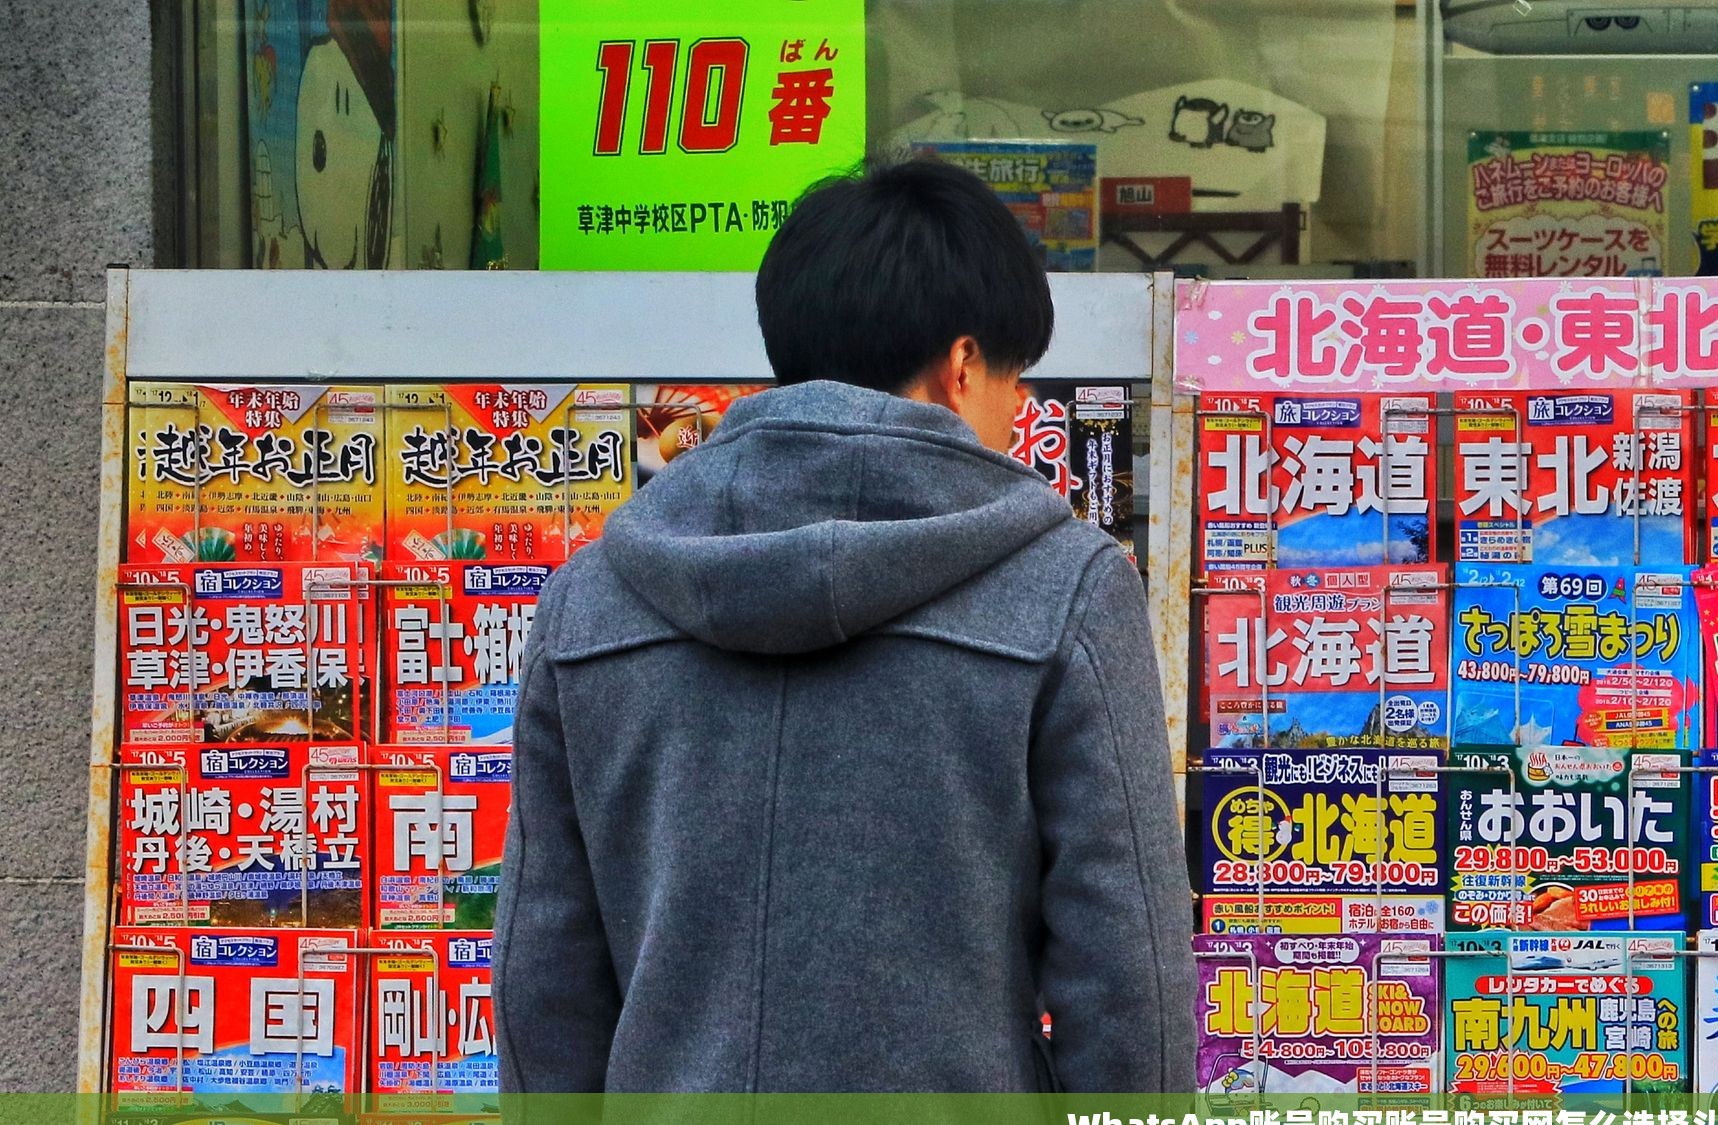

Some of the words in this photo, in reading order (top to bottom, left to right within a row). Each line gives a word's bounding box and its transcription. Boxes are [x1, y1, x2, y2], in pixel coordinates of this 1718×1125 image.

[779, 39, 839, 61] ばん
[578, 203, 792, 236] 草津中学校区PTA・防犯
[1488, 228, 1650, 250] スーツケースを
[1484, 254, 1628, 277] 無料レンタル
[229, 391, 300, 409] 年末年始
[246, 410, 280, 428] 特集
[153, 426, 376, 487] 越年お正月
[401, 426, 623, 487] 越年お正月
[1613, 432, 1681, 472] 新潟
[1102, 433, 1113, 525] お正月におすすめの
[1207, 434, 1429, 516] 北海道
[1458, 436, 1610, 517] 東北
[1613, 477, 1682, 517] 佐渡
[1275, 595, 1383, 613] 観光周遊プラン
[1542, 576, 1603, 596] 第69回
[126, 605, 347, 646] 日光・鬼怒川
[1458, 605, 1682, 664] さっぽろ雪まつり
[127, 650, 348, 690] 草津・伊香保
[1217, 616, 1435, 687] 北海道
[132, 787, 359, 834] 城崎・湯村
[1292, 794, 1437, 864] 北海道
[1460, 790, 1473, 841] おんせん県
[1478, 789, 1674, 843] おおいた
[132, 834, 360, 873] 丹後・天橋立
[1461, 875, 1527, 888] 往復新幹線
[1453, 902, 1533, 925] この価格!
[1572, 940, 1604, 950] JAL
[1206, 967, 1366, 1036] 北海道
[1488, 978, 1640, 993] レンタカーでめぐる
[132, 976, 335, 1057] 四国
[1452, 997, 1597, 1051] 南九州
[1600, 999, 1656, 1023] 鹿児島
[1657, 999, 1680, 1051] への旅
[1605, 1026, 1651, 1050] 宮崎
